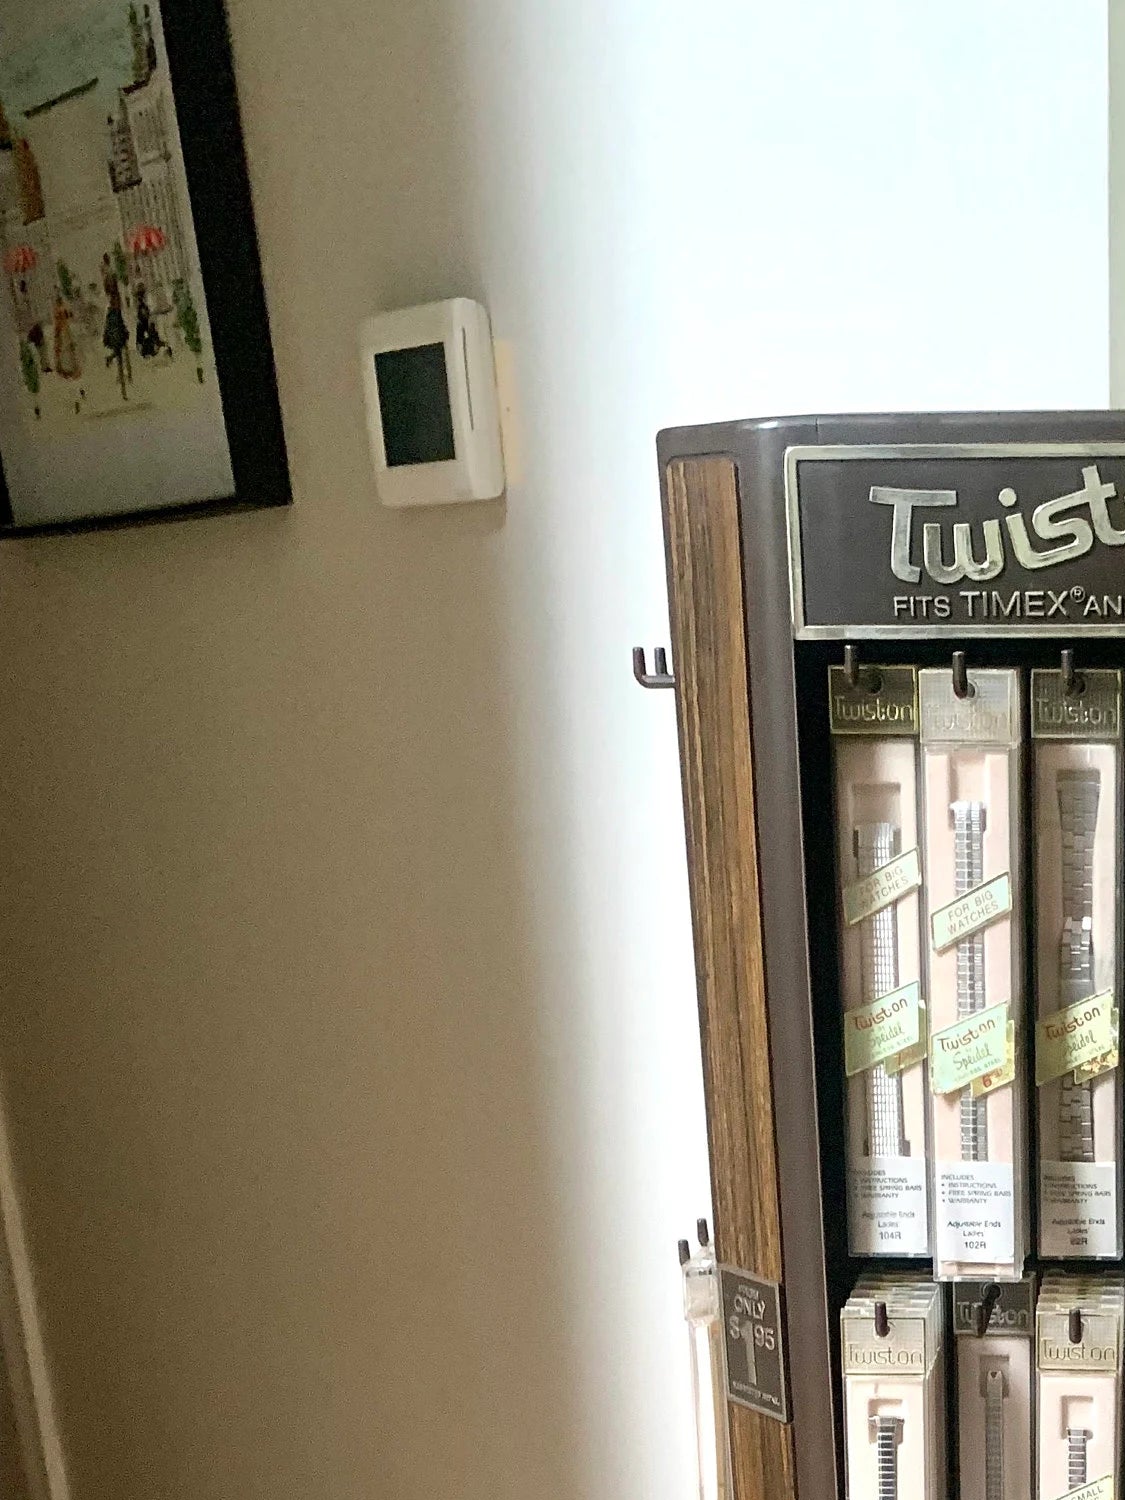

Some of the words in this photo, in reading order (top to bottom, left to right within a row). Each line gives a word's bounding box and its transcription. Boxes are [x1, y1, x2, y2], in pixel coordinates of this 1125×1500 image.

[893, 594, 951, 618] FITS
[885, 865, 903, 881] BIG
[947, 903, 970, 922] FOR
[974, 890, 994, 907] BIG
[947, 900, 1000, 934] WATCHES
[963, 1240, 987, 1250] 102R
[733, 1293, 766, 1321] ONLY
